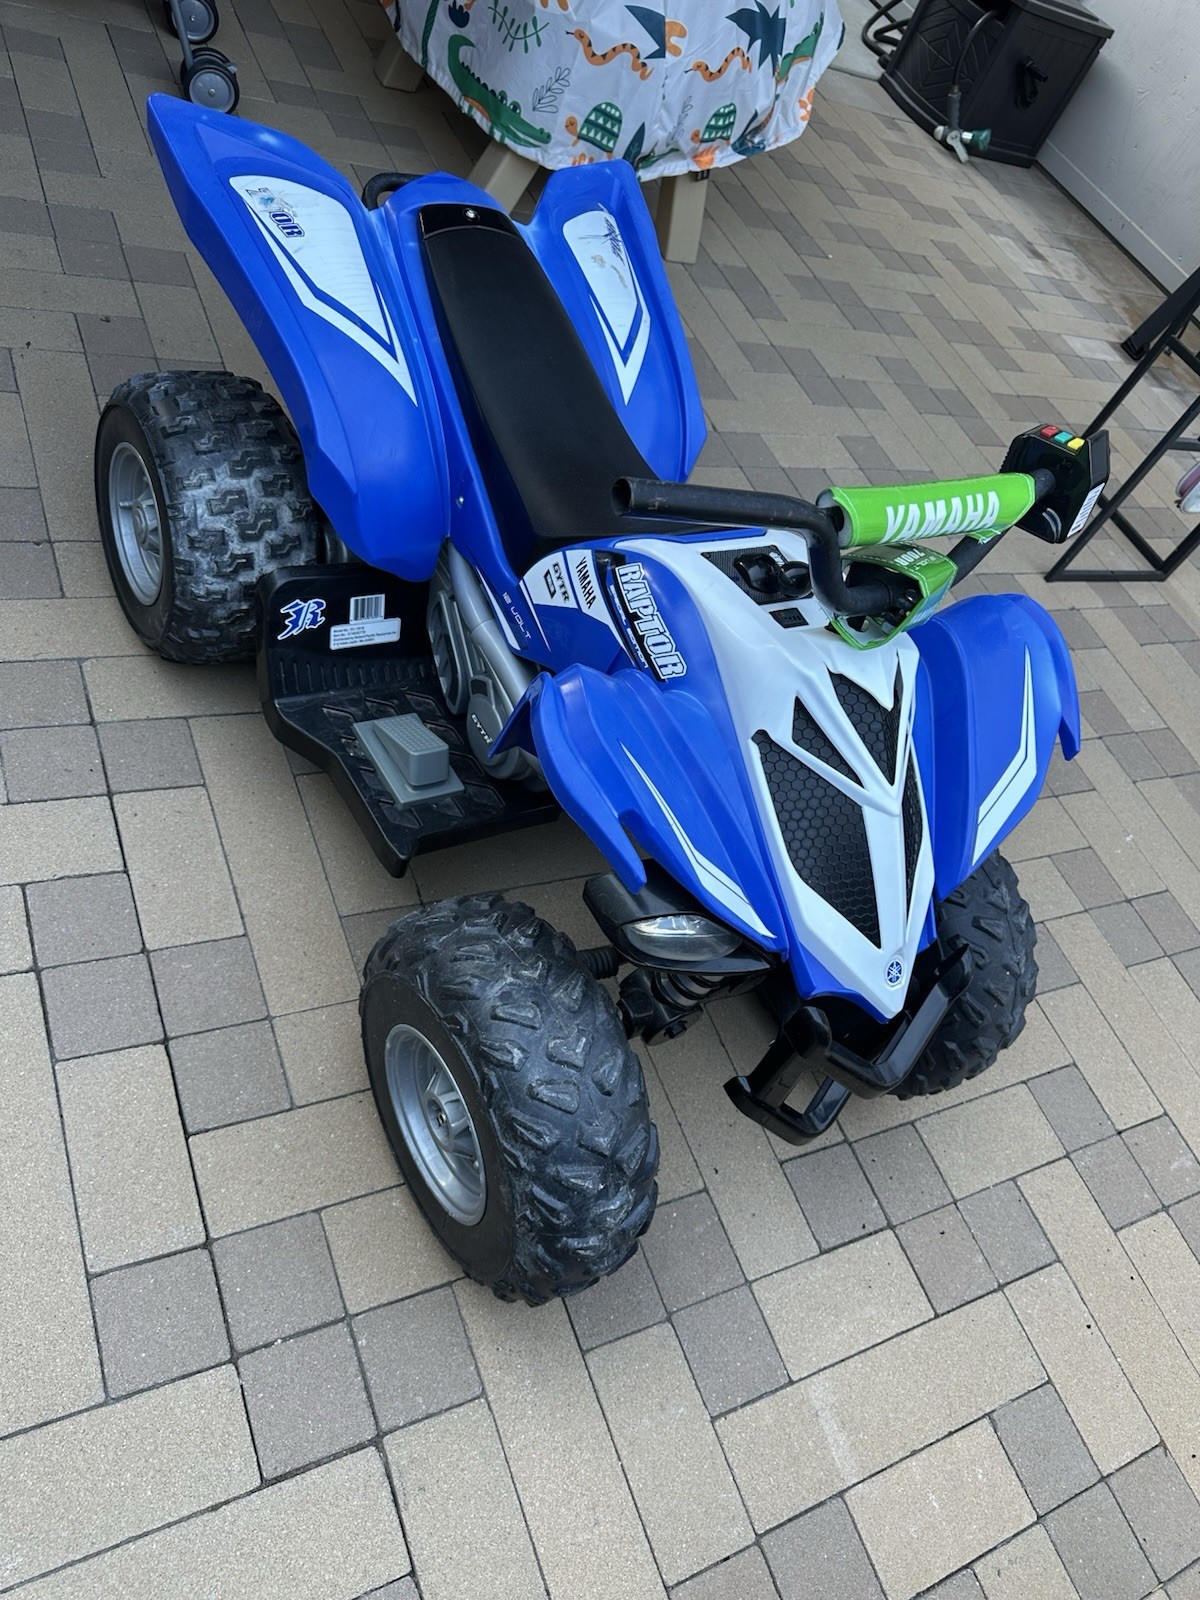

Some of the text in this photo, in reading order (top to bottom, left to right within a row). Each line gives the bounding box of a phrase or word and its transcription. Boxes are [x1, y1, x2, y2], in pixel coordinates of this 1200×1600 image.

[877, 491, 1000, 544] YAMAHA
[553, 561, 570, 603] GYTR
[576, 556, 597, 609] YAMAHA
[510, 606, 532, 639] VOLT
[616, 562, 687, 679] RAPTOR
